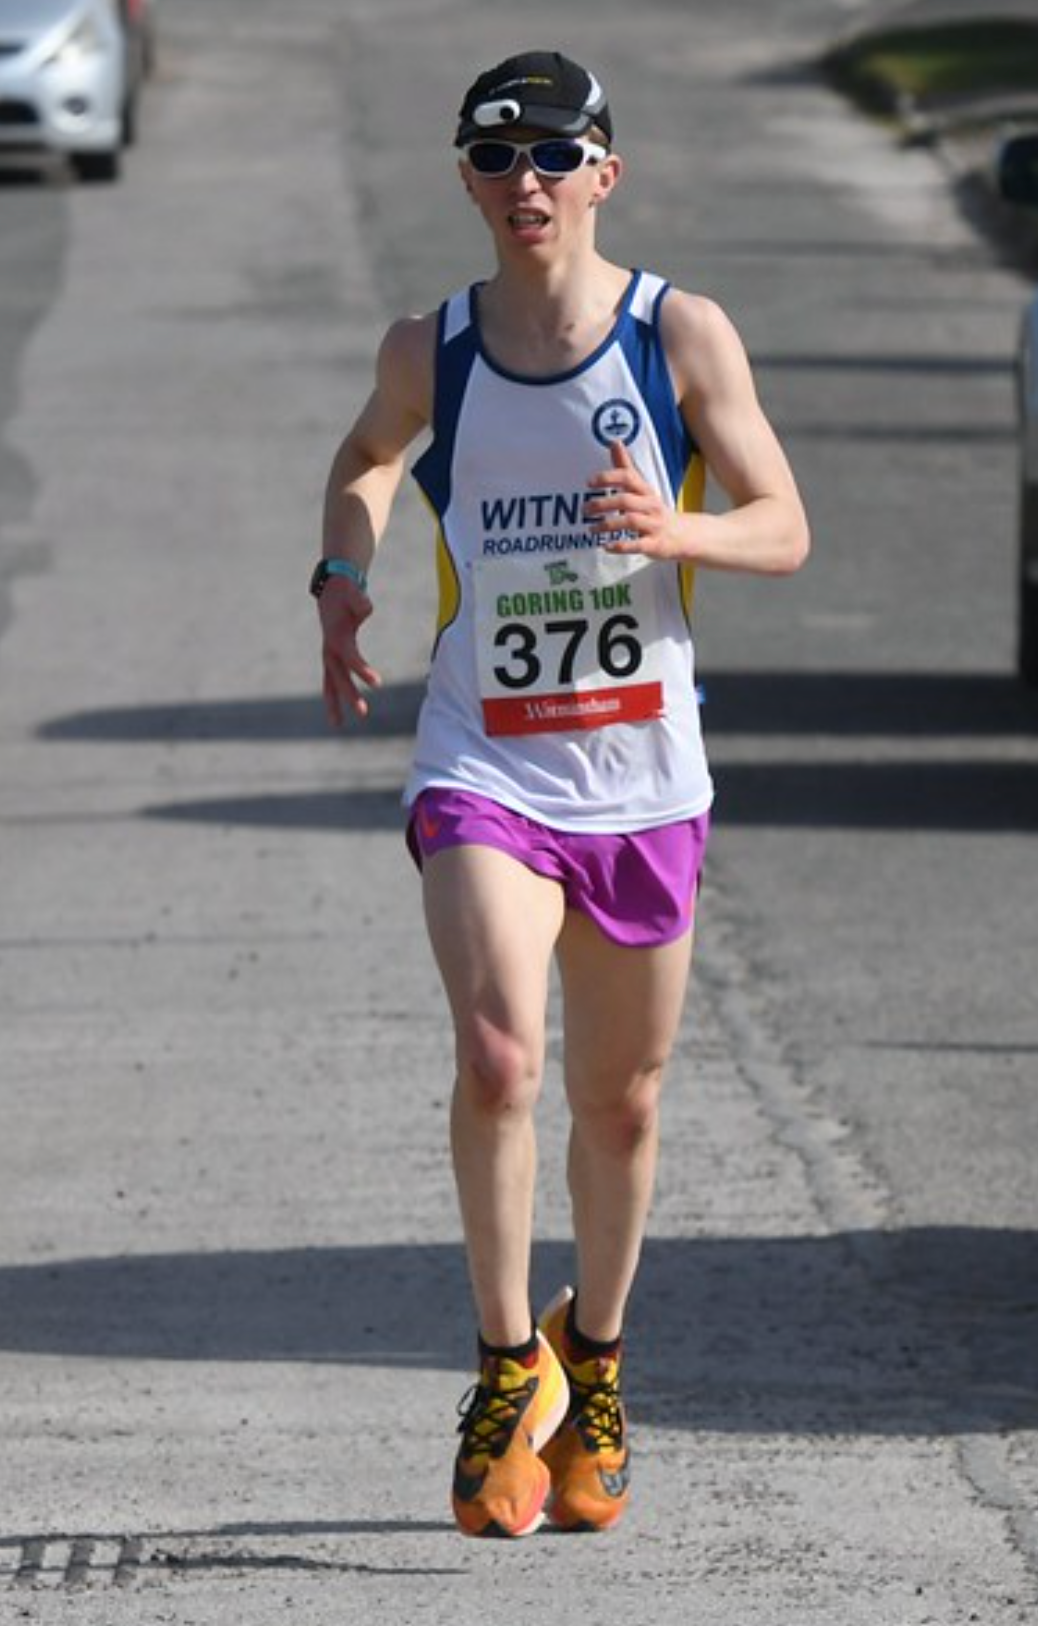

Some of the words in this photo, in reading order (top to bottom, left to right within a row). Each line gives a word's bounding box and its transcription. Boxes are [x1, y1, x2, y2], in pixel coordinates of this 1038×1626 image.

[481, 491, 619, 531] WITNE
[496, 588, 583, 617] GORING
[589, 583, 632, 610] 10K
[493, 613, 643, 689] 376
